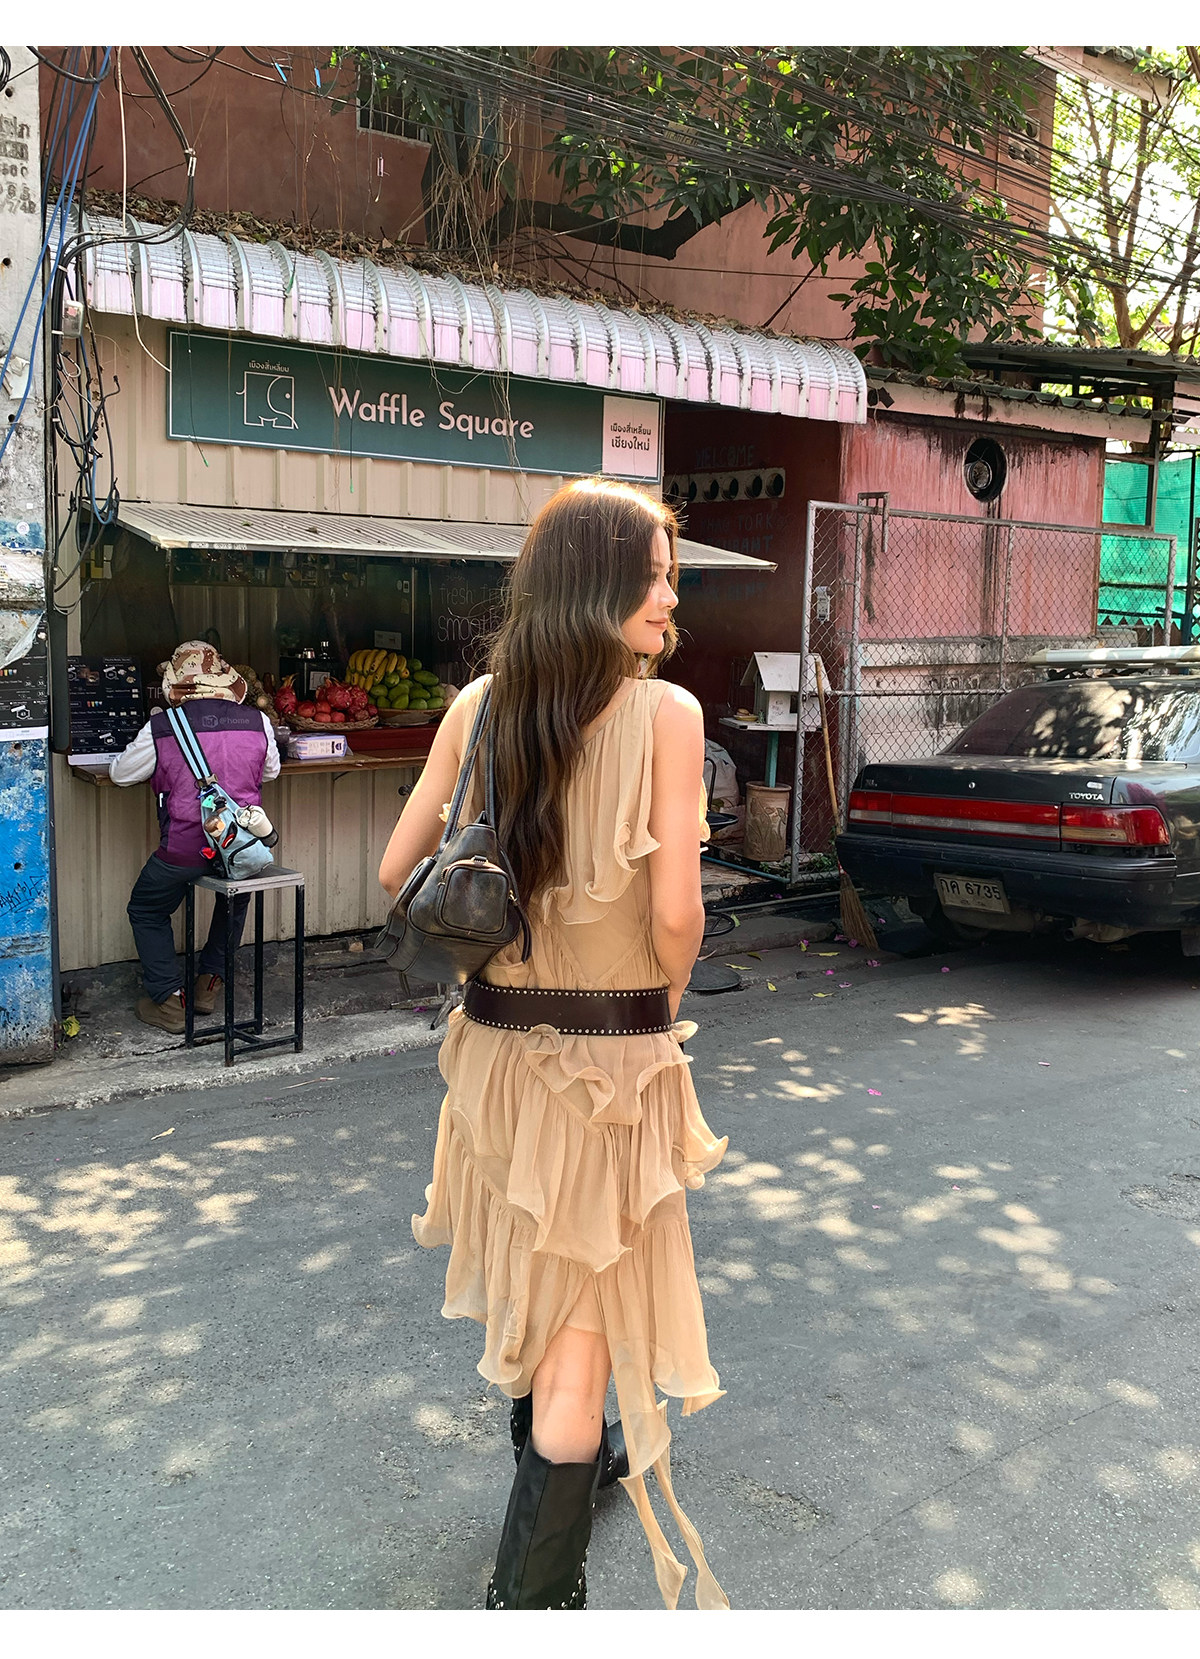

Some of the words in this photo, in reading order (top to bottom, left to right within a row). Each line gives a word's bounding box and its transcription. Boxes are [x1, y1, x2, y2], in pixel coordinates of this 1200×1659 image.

[328, 386, 426, 428] Waffle
[437, 401, 535, 440] Square
[611, 436, 650, 451] เชียงใหม่
[439, 581, 474, 606] fresh
[1069, 792, 1104, 801] TOYOTA
[964, 882, 1002, 900] 6735
